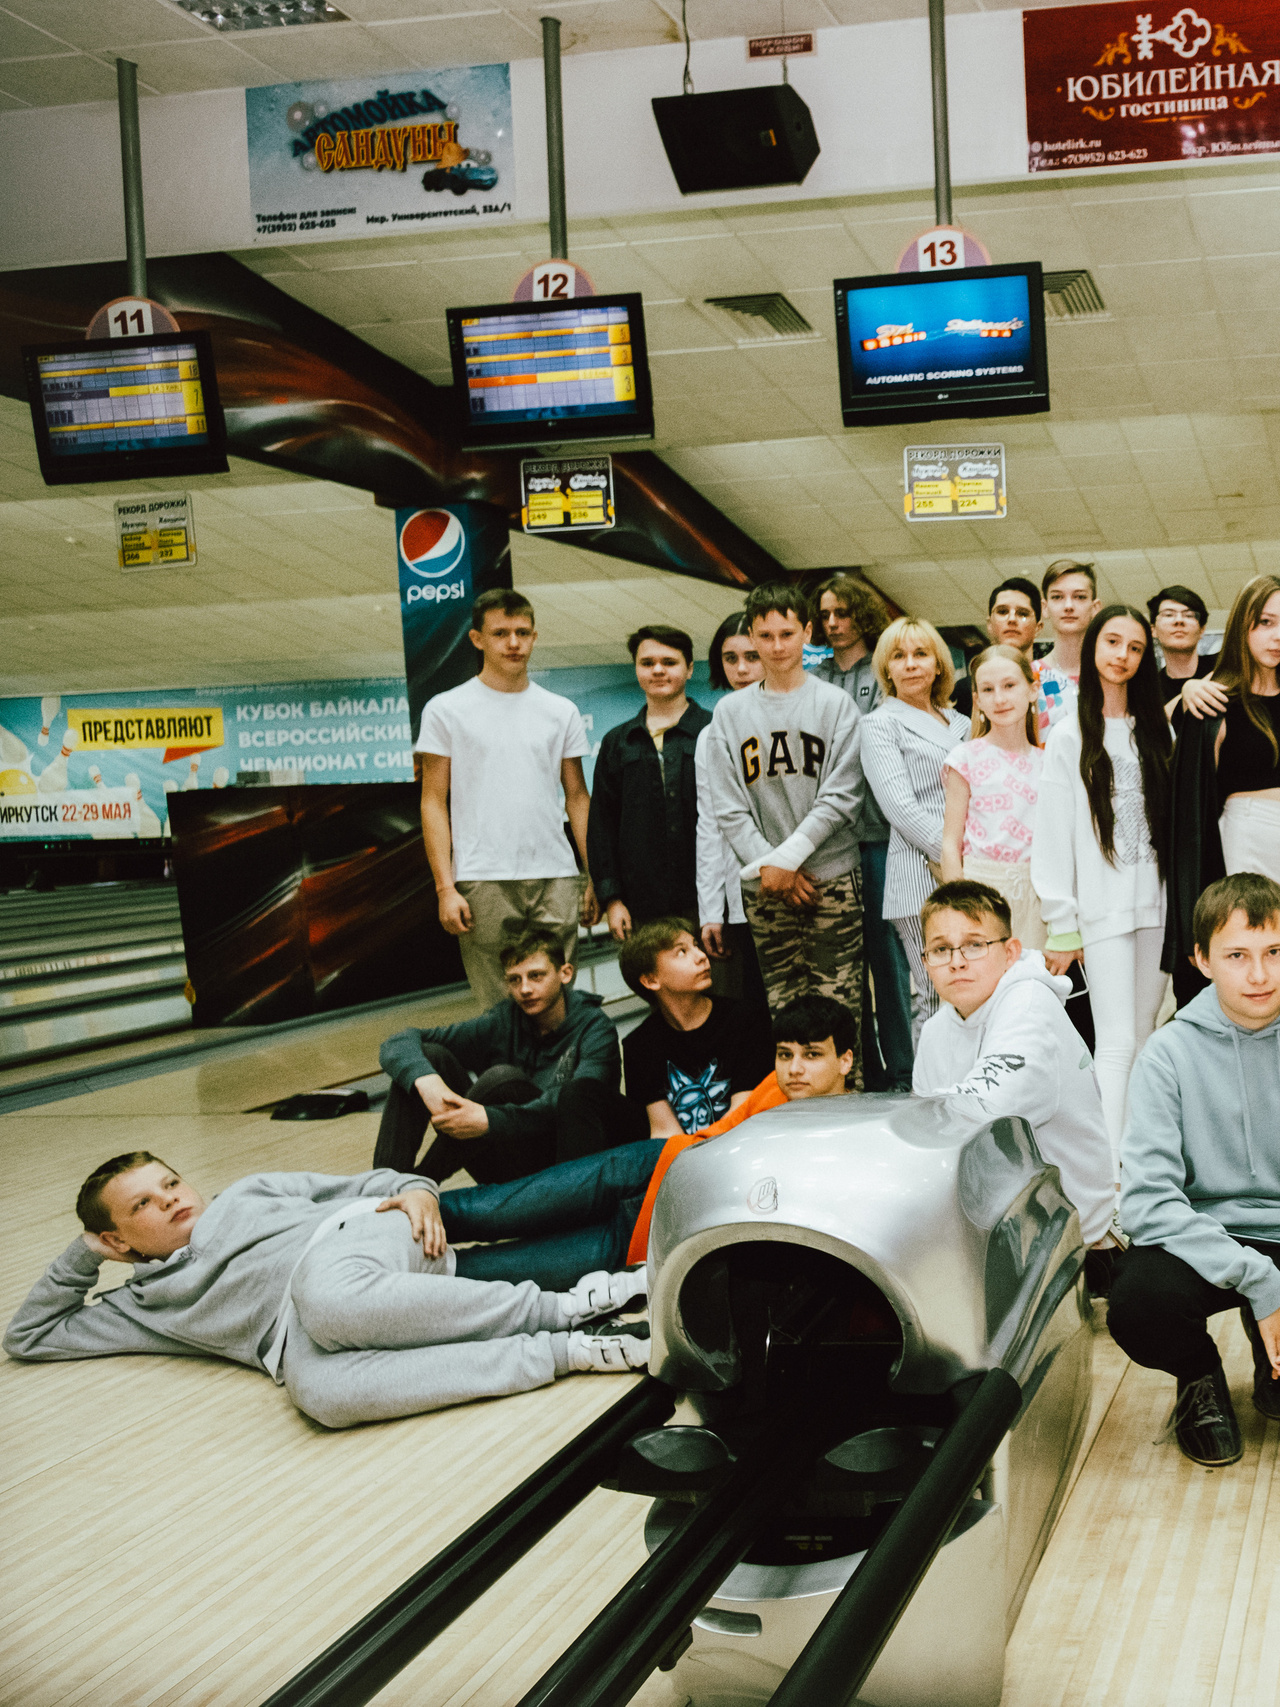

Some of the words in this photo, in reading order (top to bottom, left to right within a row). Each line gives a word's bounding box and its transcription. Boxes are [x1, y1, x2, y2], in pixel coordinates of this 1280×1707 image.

[1120, 96, 1228, 118] гостиница
[292, 90, 448, 158] АВТОМОЙКА
[316, 122, 457, 172] САНДУНЫ
[256, 212, 297, 222] Телефон
[300, 210, 318, 220] для
[924, 240, 958, 267] 13
[537, 273, 569, 299] 12
[114, 308, 145, 335] 11
[866, 372, 924, 386] AUTOMATIC
[926, 368, 974, 380] SCORING
[975, 365, 1024, 376] SYSTEMS
[118, 504, 146, 516] РЕКОРД
[148, 500, 186, 512] ДОРОЖКИ
[407, 580, 464, 604] pepsi
[236, 702, 304, 722] КУБОК
[310, 696, 410, 718] БАЙКАЛА
[82, 714, 214, 744] ПРЕДСТАВЛЯЮТ
[238, 722, 412, 748] ВСЕРОССИЙСКИЕ
[240, 752, 368, 772] ЧЕМПИОНАТ
[740, 730, 825, 786] GAP
[0, 805, 58, 823] ИРКУТСК
[62, 803, 98, 822] 22-29
[102, 802, 131, 820] МАЯ
